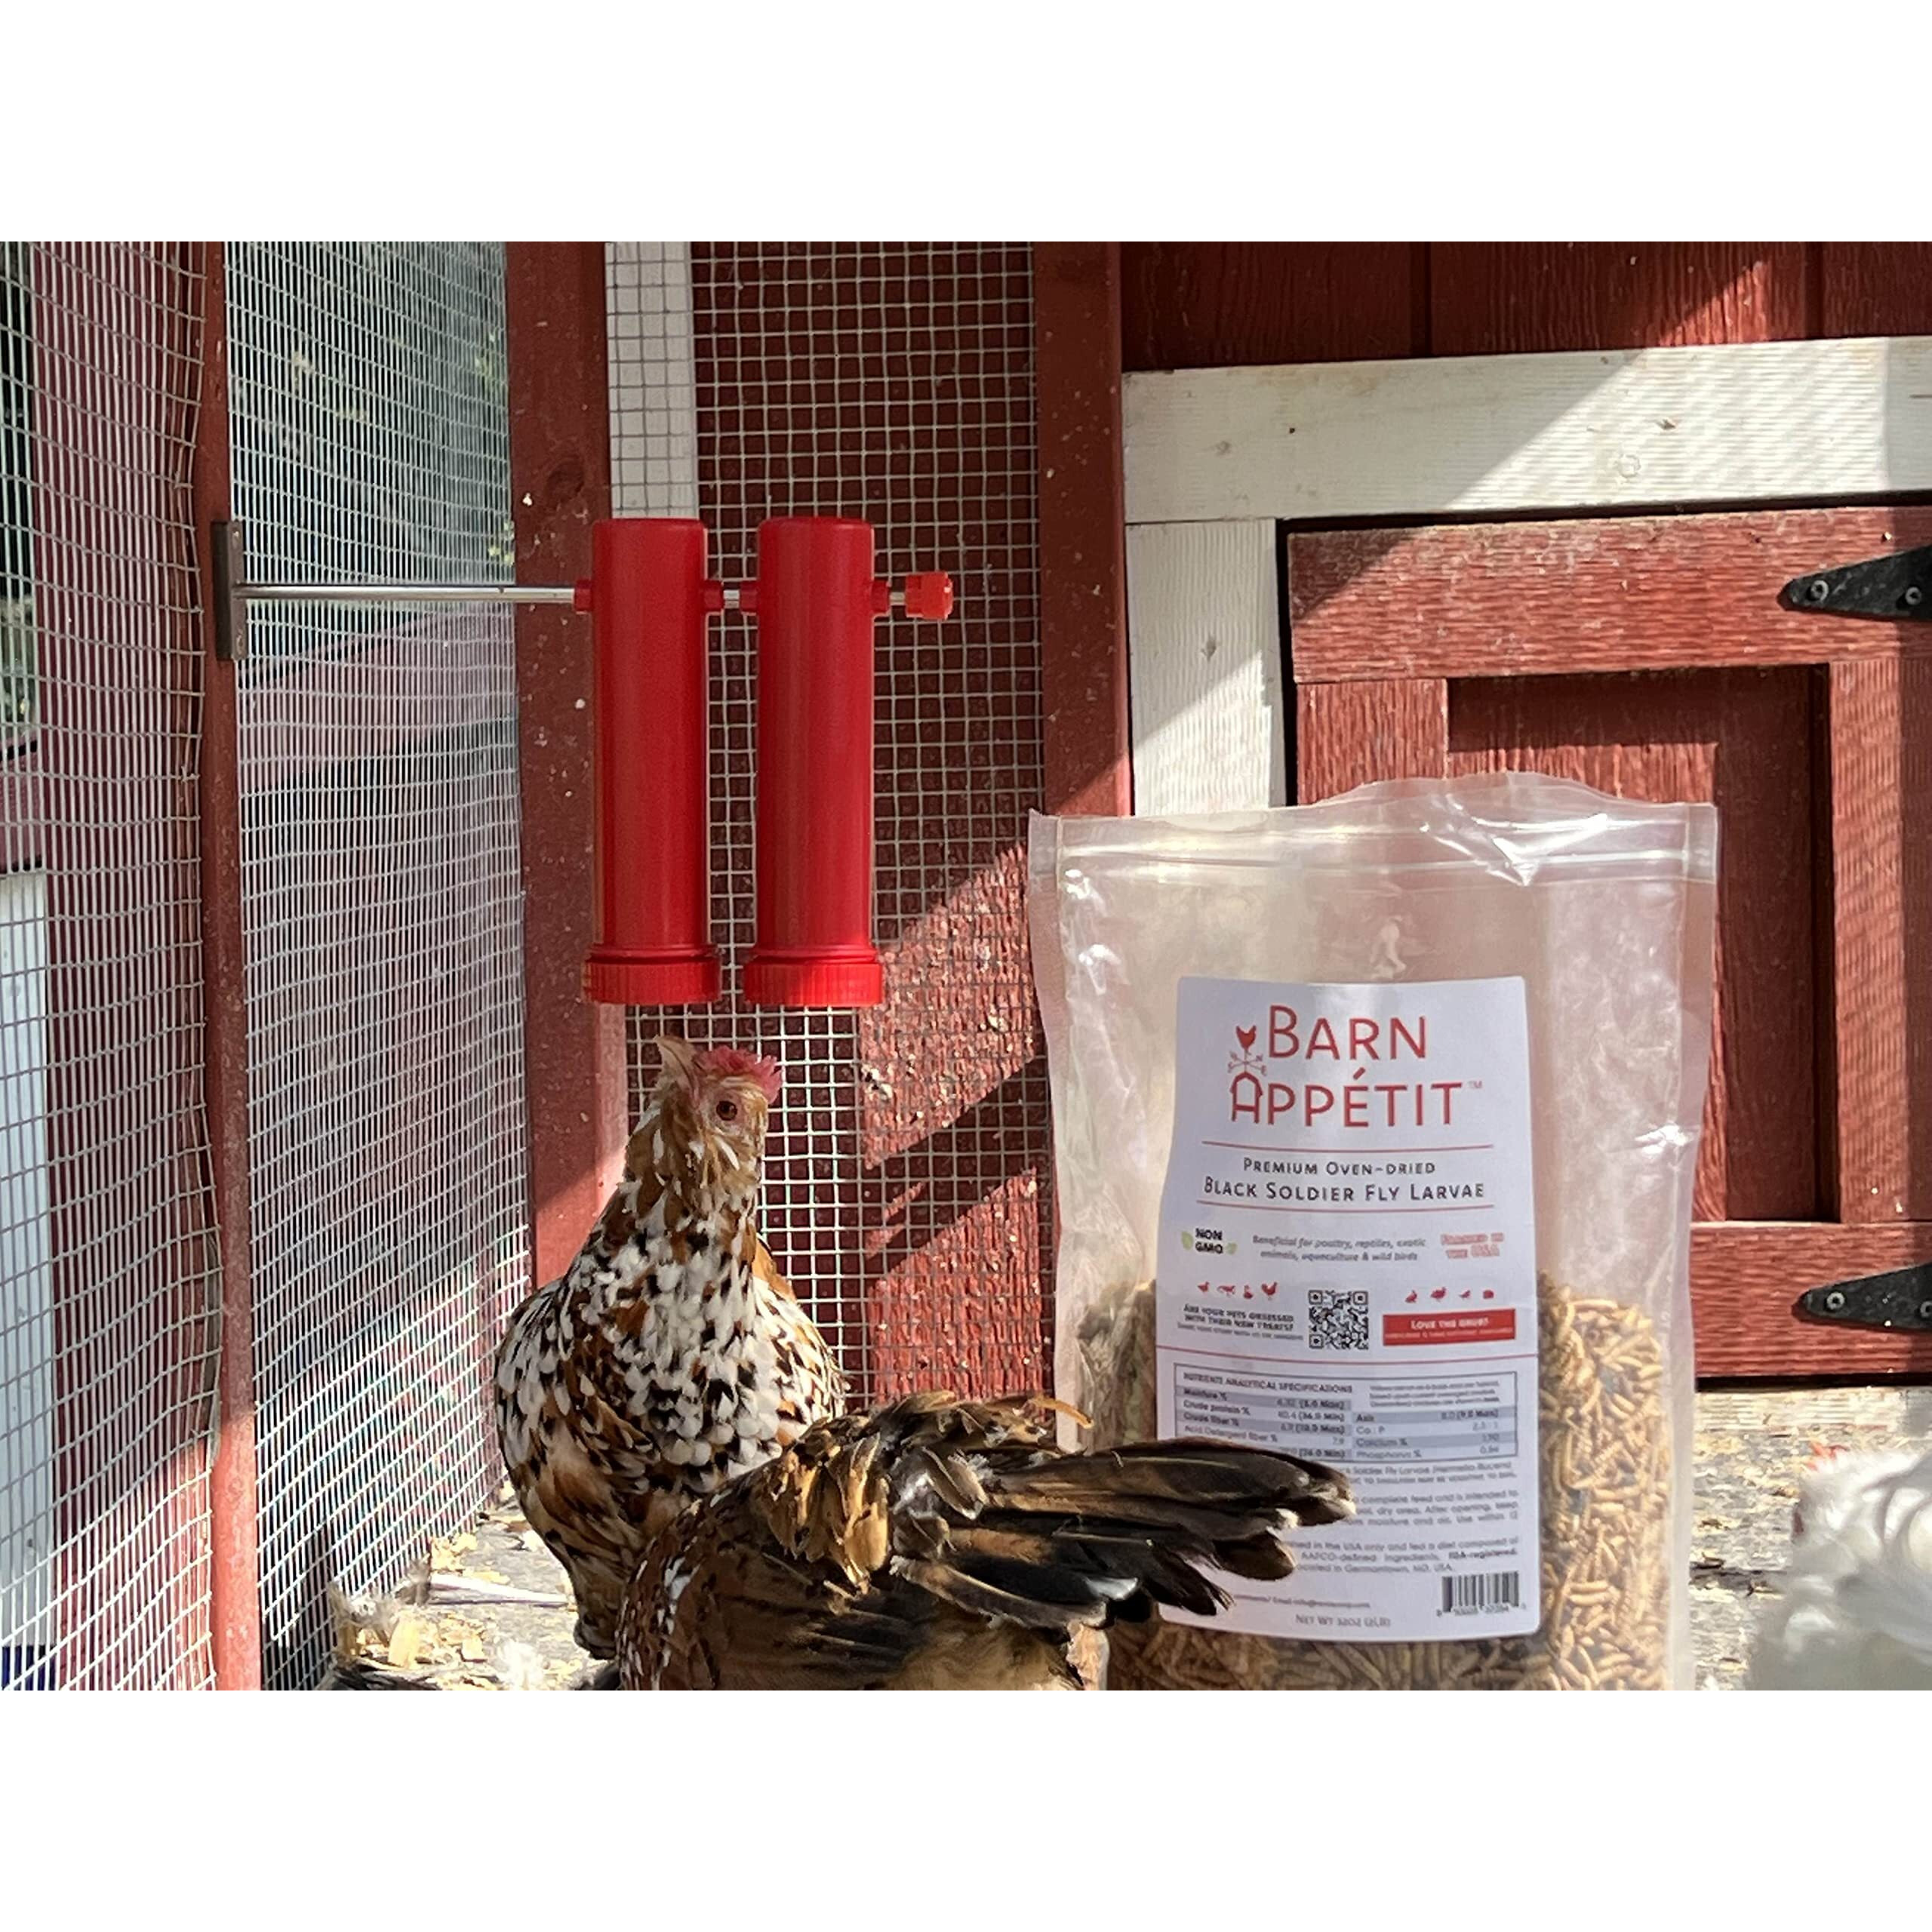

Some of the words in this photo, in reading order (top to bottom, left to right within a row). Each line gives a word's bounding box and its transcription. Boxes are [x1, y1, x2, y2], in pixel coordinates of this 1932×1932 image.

[1268, 1004, 1426, 1060] BARN
[1229, 1066, 1463, 1128] APPÉTIT
[1244, 1157, 1318, 1175] PREMIUM
[1327, 1161, 1435, 1176] OVEN-DRIED
[1204, 1176, 1258, 1198] BLACK
[1266, 1181, 1354, 1201] SOLDIER
[1365, 1183, 1400, 1201] FLY
[1410, 1183, 1484, 1201] LARVAE
[1195, 1228, 1223, 1241] NON
[1195, 1241, 1223, 1254] GMO
[1253, 1235, 1297, 1246] Beneficial
[1297, 1237, 1312, 1249] for
[1372, 1252, 1392, 1261] wild
[1411, 1319, 1435, 1329] LOVE
[1225, 1377, 1277, 1391] ANALYTICAL
[1278, 1383, 1353, 1394] SPECIFICATIONS
[1218, 1392, 1228, 1401] %
[1241, 1407, 1251, 1416] %
[1399, 1437, 1407, 1447] %
[1414, 1449, 1422, 1458] %
